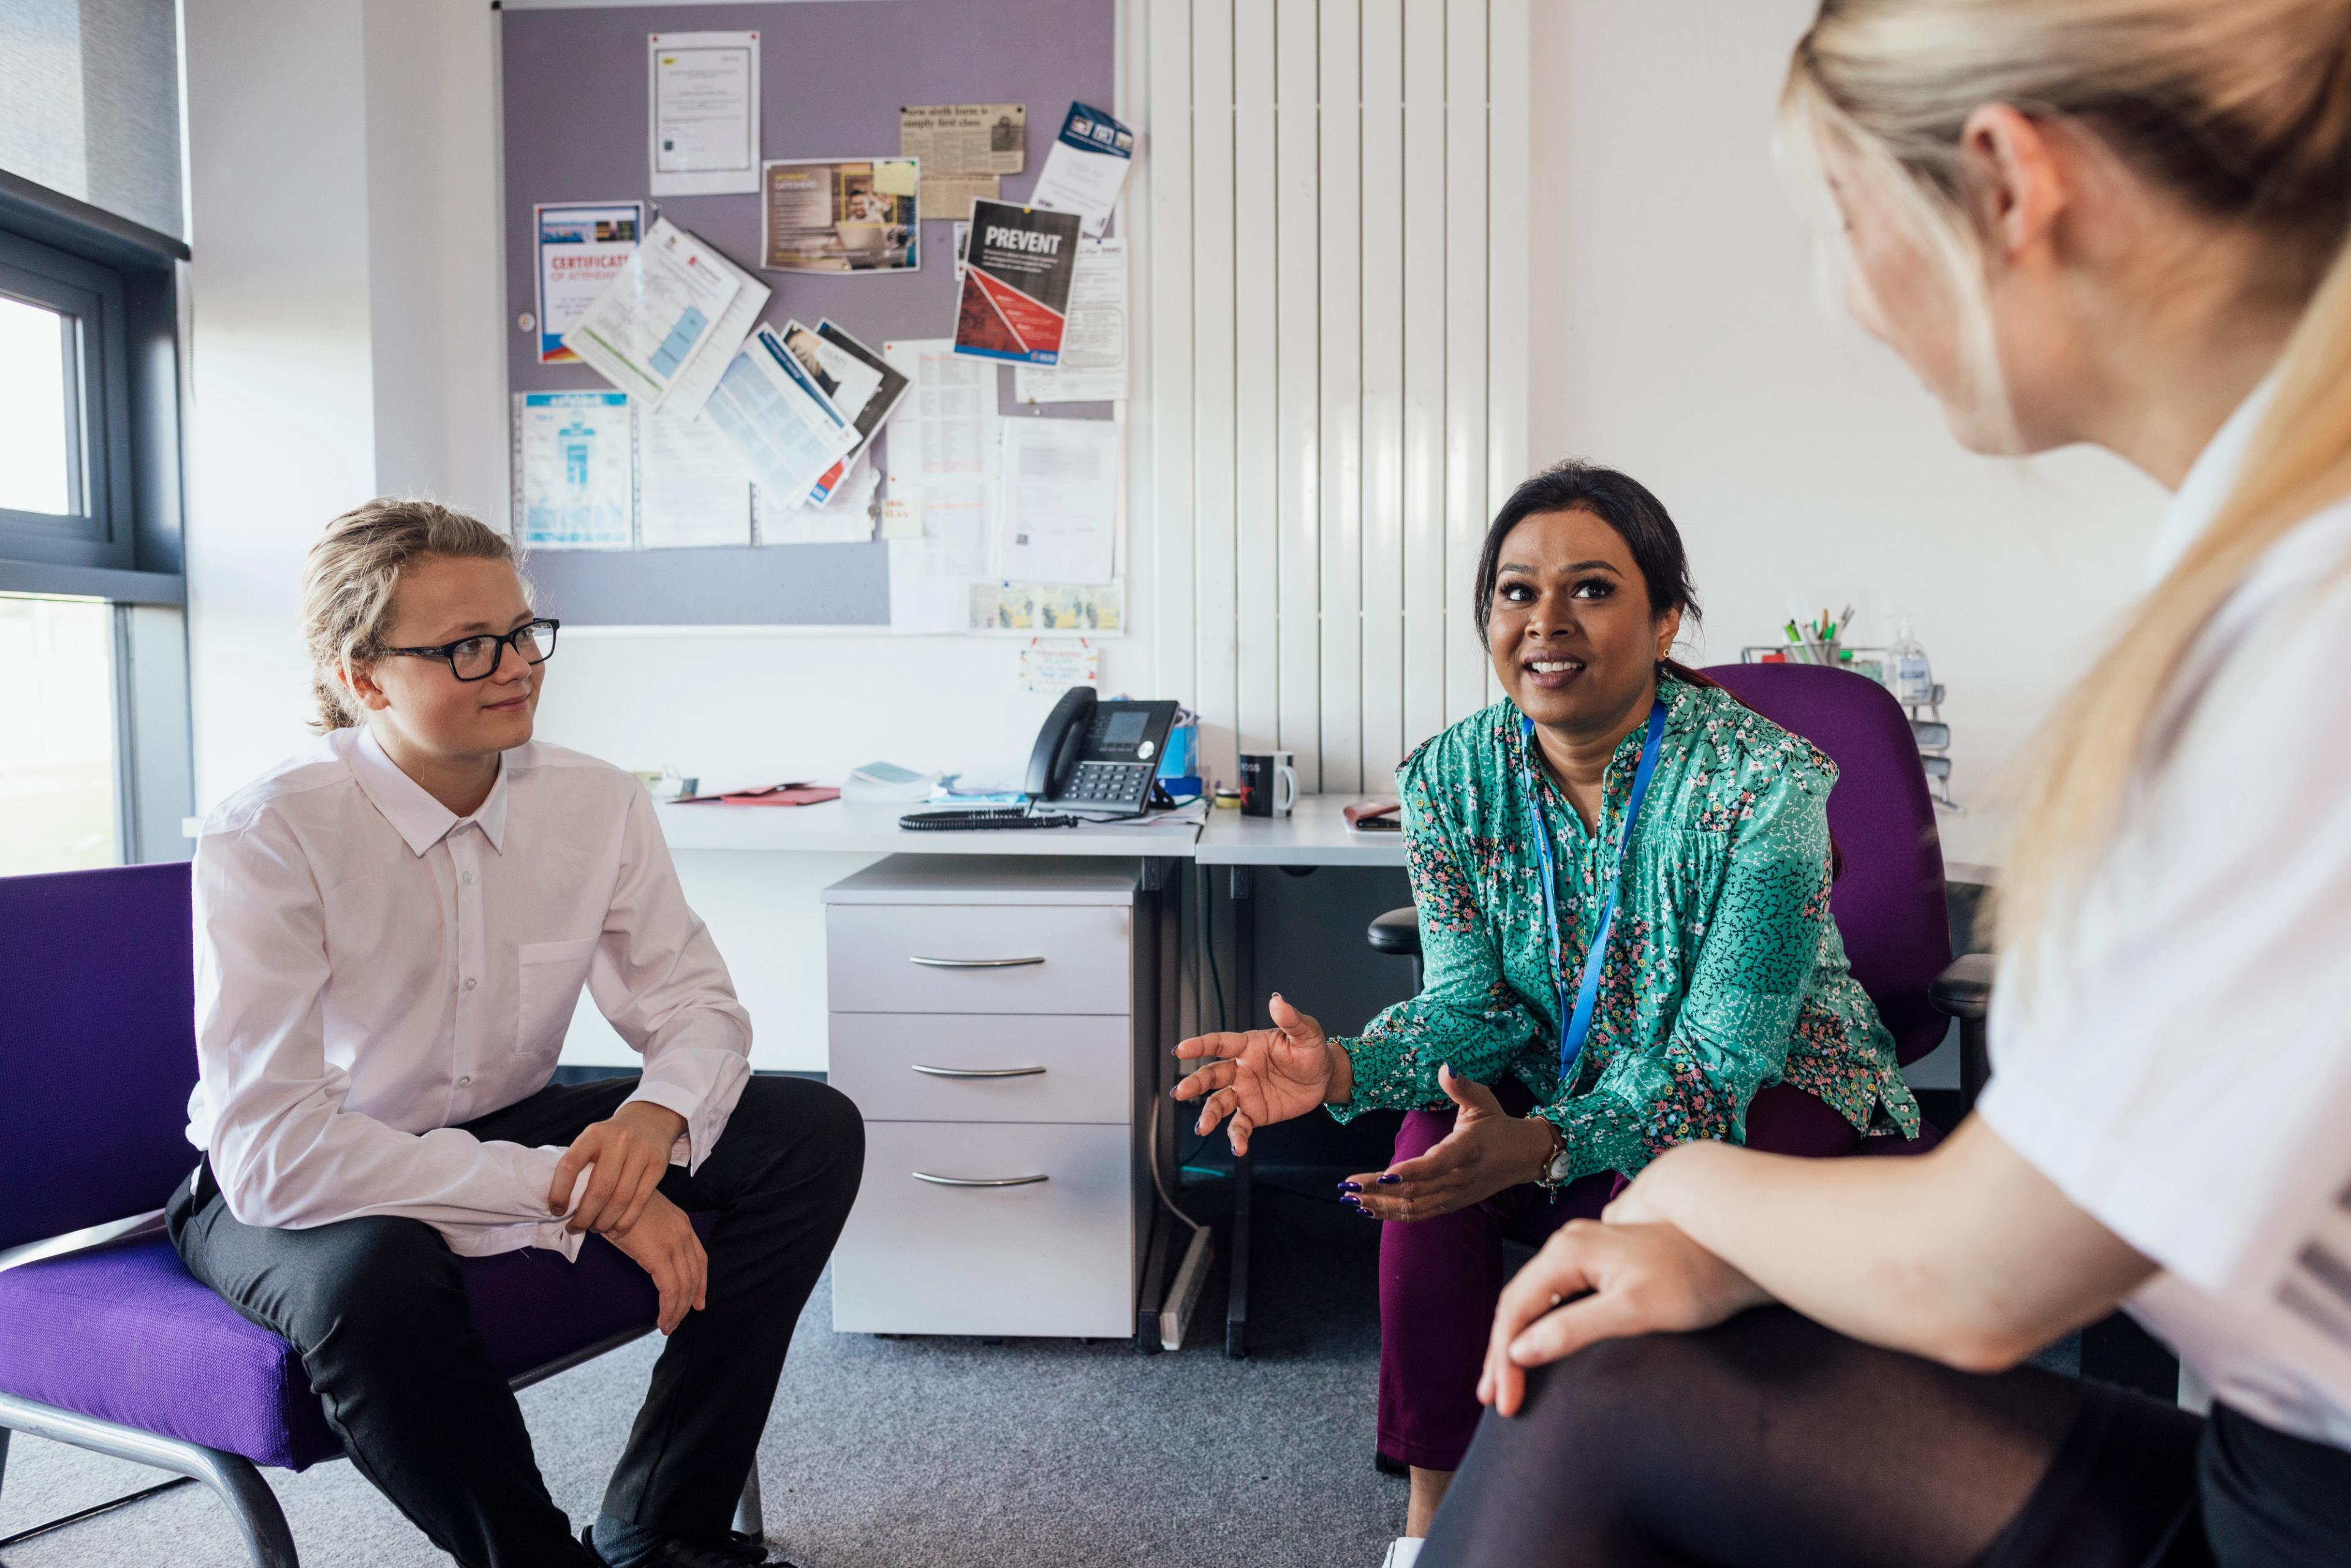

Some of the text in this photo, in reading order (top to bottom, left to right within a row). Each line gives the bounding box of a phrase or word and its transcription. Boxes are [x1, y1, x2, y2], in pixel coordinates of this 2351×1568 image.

[955, 107, 978, 116] form
[904, 118, 981, 129] simply first class
[984, 225, 1063, 255] PREVENT
